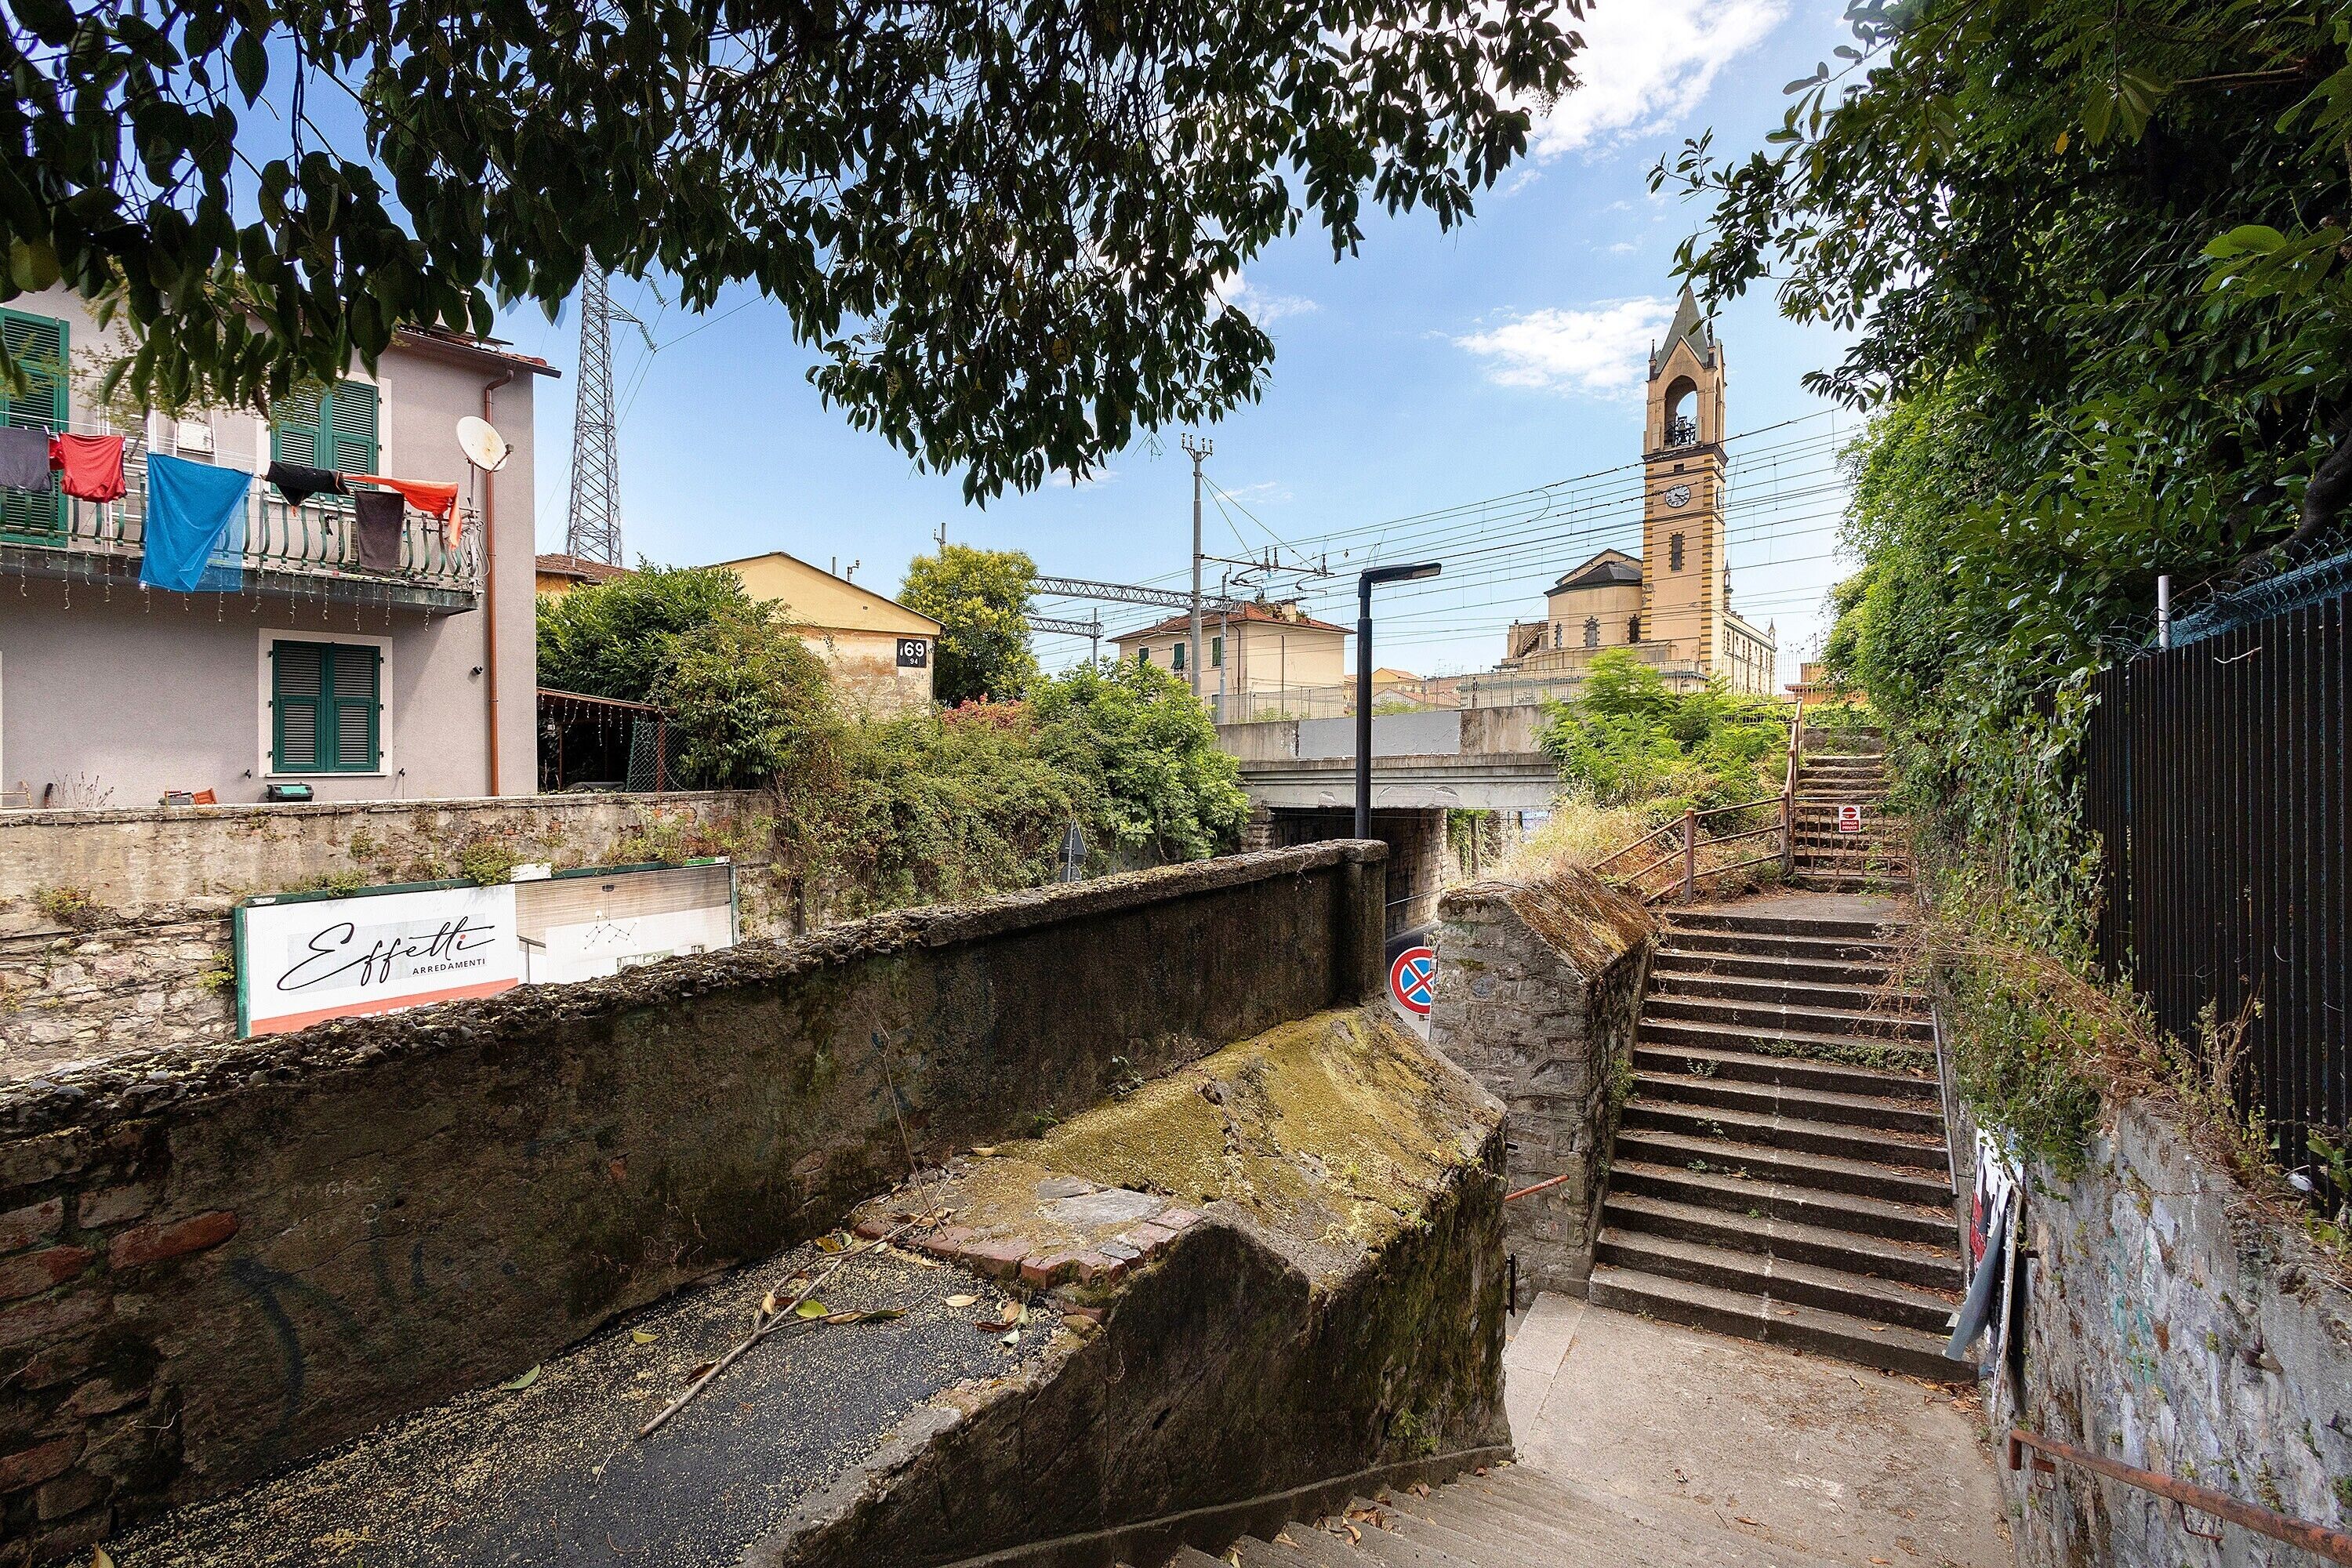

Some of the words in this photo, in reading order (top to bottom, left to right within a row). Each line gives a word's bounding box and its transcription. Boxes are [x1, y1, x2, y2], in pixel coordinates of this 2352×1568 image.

[899, 641, 924, 657] 169
[277, 916, 495, 991] Effetti
[412, 958, 486, 975] ARREDAMENTI
